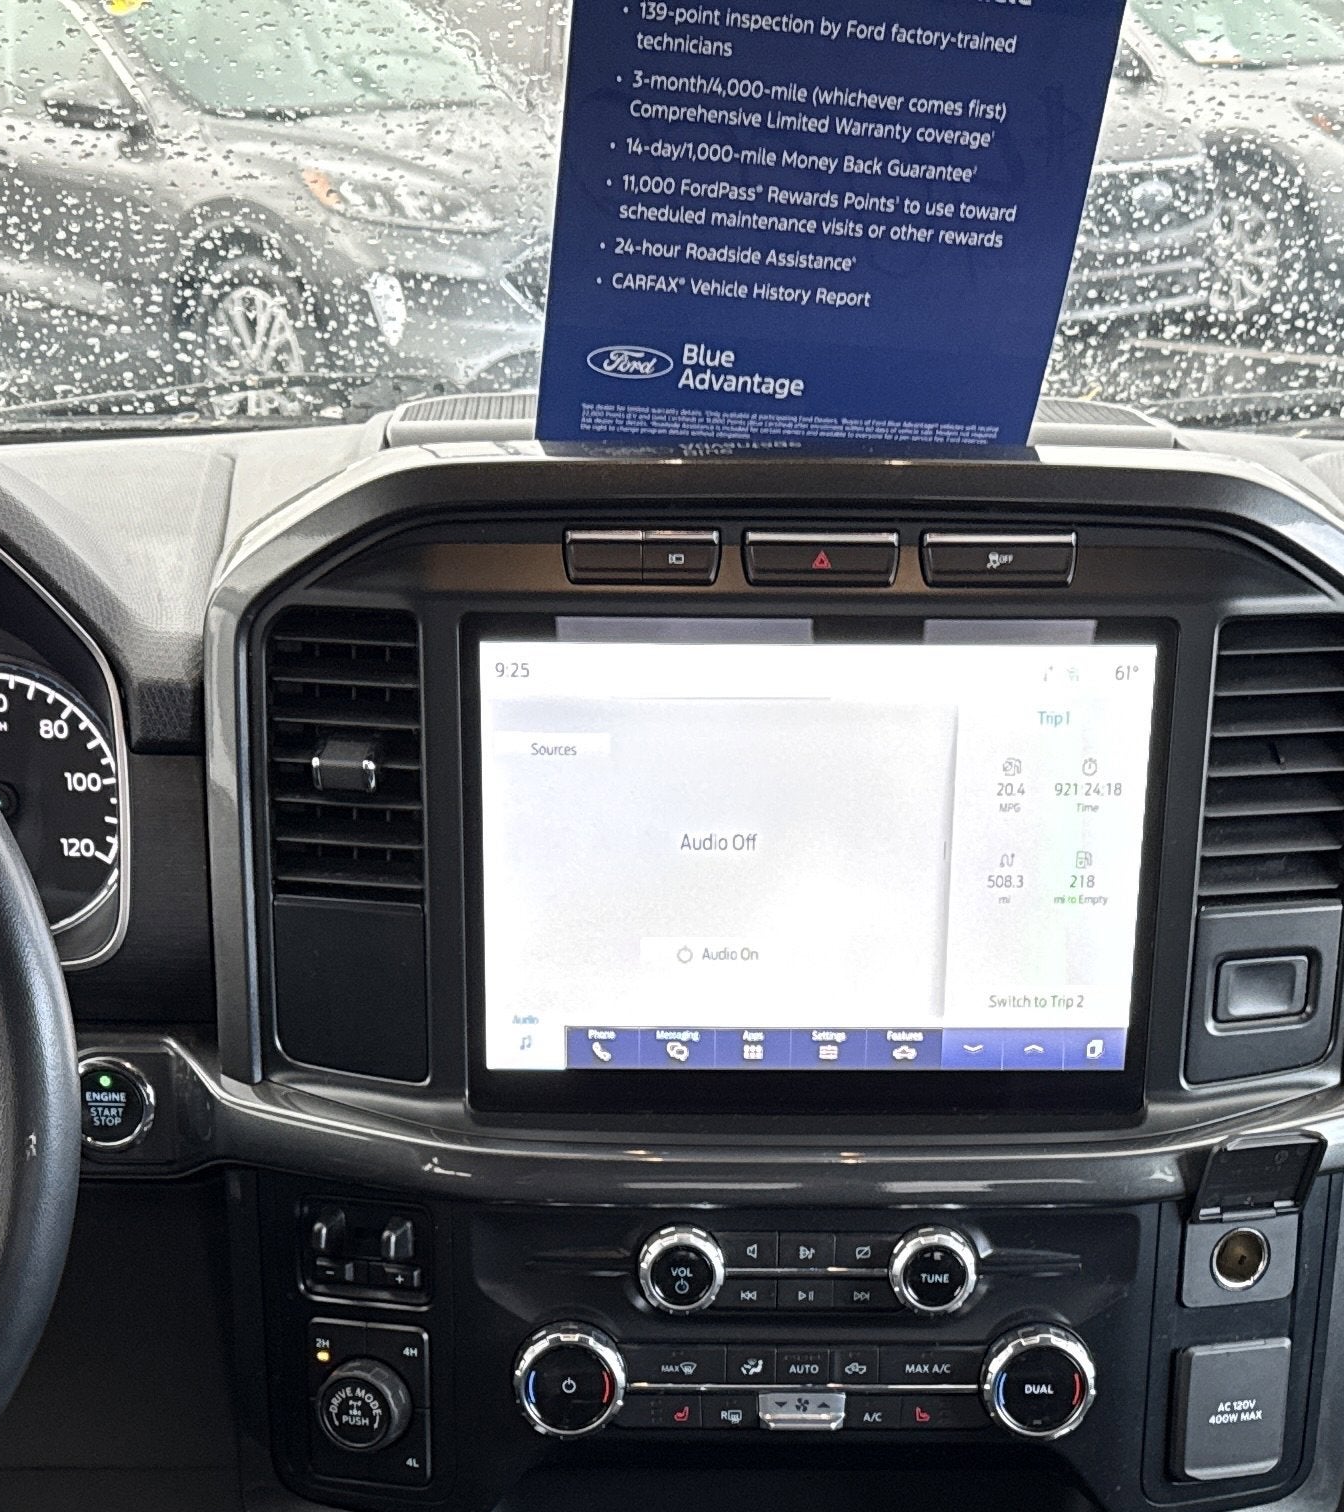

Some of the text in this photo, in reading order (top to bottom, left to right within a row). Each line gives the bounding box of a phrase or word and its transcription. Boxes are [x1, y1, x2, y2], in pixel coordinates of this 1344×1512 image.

[640, 1, 1017, 54] 139-point inspection by Ford factory-trained
[637, 32, 732, 57] technicians
[632, 70, 1006, 123] 3-month/4,000-mile (whichever comes first)
[630, 99, 761, 127] Comprehensive
[767, 111, 829, 134] Limited
[836, 117, 912, 143] Warranty
[626, 137, 777, 167] 14-day/1,000-mile
[782, 150, 838, 174] Money
[843, 155, 882, 175] Back
[622, 174, 675, 195] 11,000
[768, 185, 838, 208] Rewards
[904, 198, 920, 215] to
[926, 201, 954, 218] use
[959, 202, 1017, 222] toward
[619, 202, 1003, 248] scheduled maintenance visits or other rewards
[614, 238, 681, 258] 24-hour
[686, 243, 761, 264] Roadside
[690, 278, 748, 298] Vehicle
[753, 283, 811, 306] History
[816, 288, 871, 309] Report
[682, 343, 735, 368] Blue
[603, 350, 657, 375] Ford
[678, 368, 804, 400] Advantage
[494, 662, 530, 678] 9:25
[1037, 711, 1063, 728] Trip
[39, 719, 69, 739] 80
[531, 743, 577, 756] Sources
[64, 772, 101, 792] 100
[997, 782, 1025, 796] 20.4
[999, 803, 1021, 812] MPG
[1077, 803, 1099, 812] Time
[60, 838, 94, 858] 120
[680, 833, 757, 851] Audio Off
[987, 875, 1024, 888] 508.3
[1070, 875, 1095, 888] 218
[1079, 895, 1108, 905] Empty
[701, 947, 759, 961] Audio On
[989, 995, 1084, 1011] Switch to Trip 2
[588, 1029, 616, 1040] Phone
[656, 1030, 700, 1041] Messaging
[742, 1030, 765, 1042] Apps
[812, 1030, 846, 1042] Settings
[887, 1029, 923, 1041] Features
[85, 1091, 127, 1102] ENGINE
[90, 1107, 123, 1117] START
[93, 1117, 122, 1126] STOP
[670, 1267, 693, 1278] VOL
[920, 1273, 950, 1284] TUNE
[316, 1338, 330, 1349] 2H
[403, 1347, 418, 1358] 4H
[661, 1364, 680, 1373] MAX
[789, 1364, 820, 1374] AUTO
[905, 1364, 951, 1374] MAX A/C
[1024, 1384, 1055, 1395] DUAL
[328, 1386, 383, 1417] DRIVE MODE
[1218, 1398, 1256, 1413] AC 120V
[342, 1415, 370, 1426] PUSH
[863, 1411, 883, 1423] A/C
[1209, 1409, 1263, 1425] 400W MAX
[406, 1457, 419, 1469] 4L
